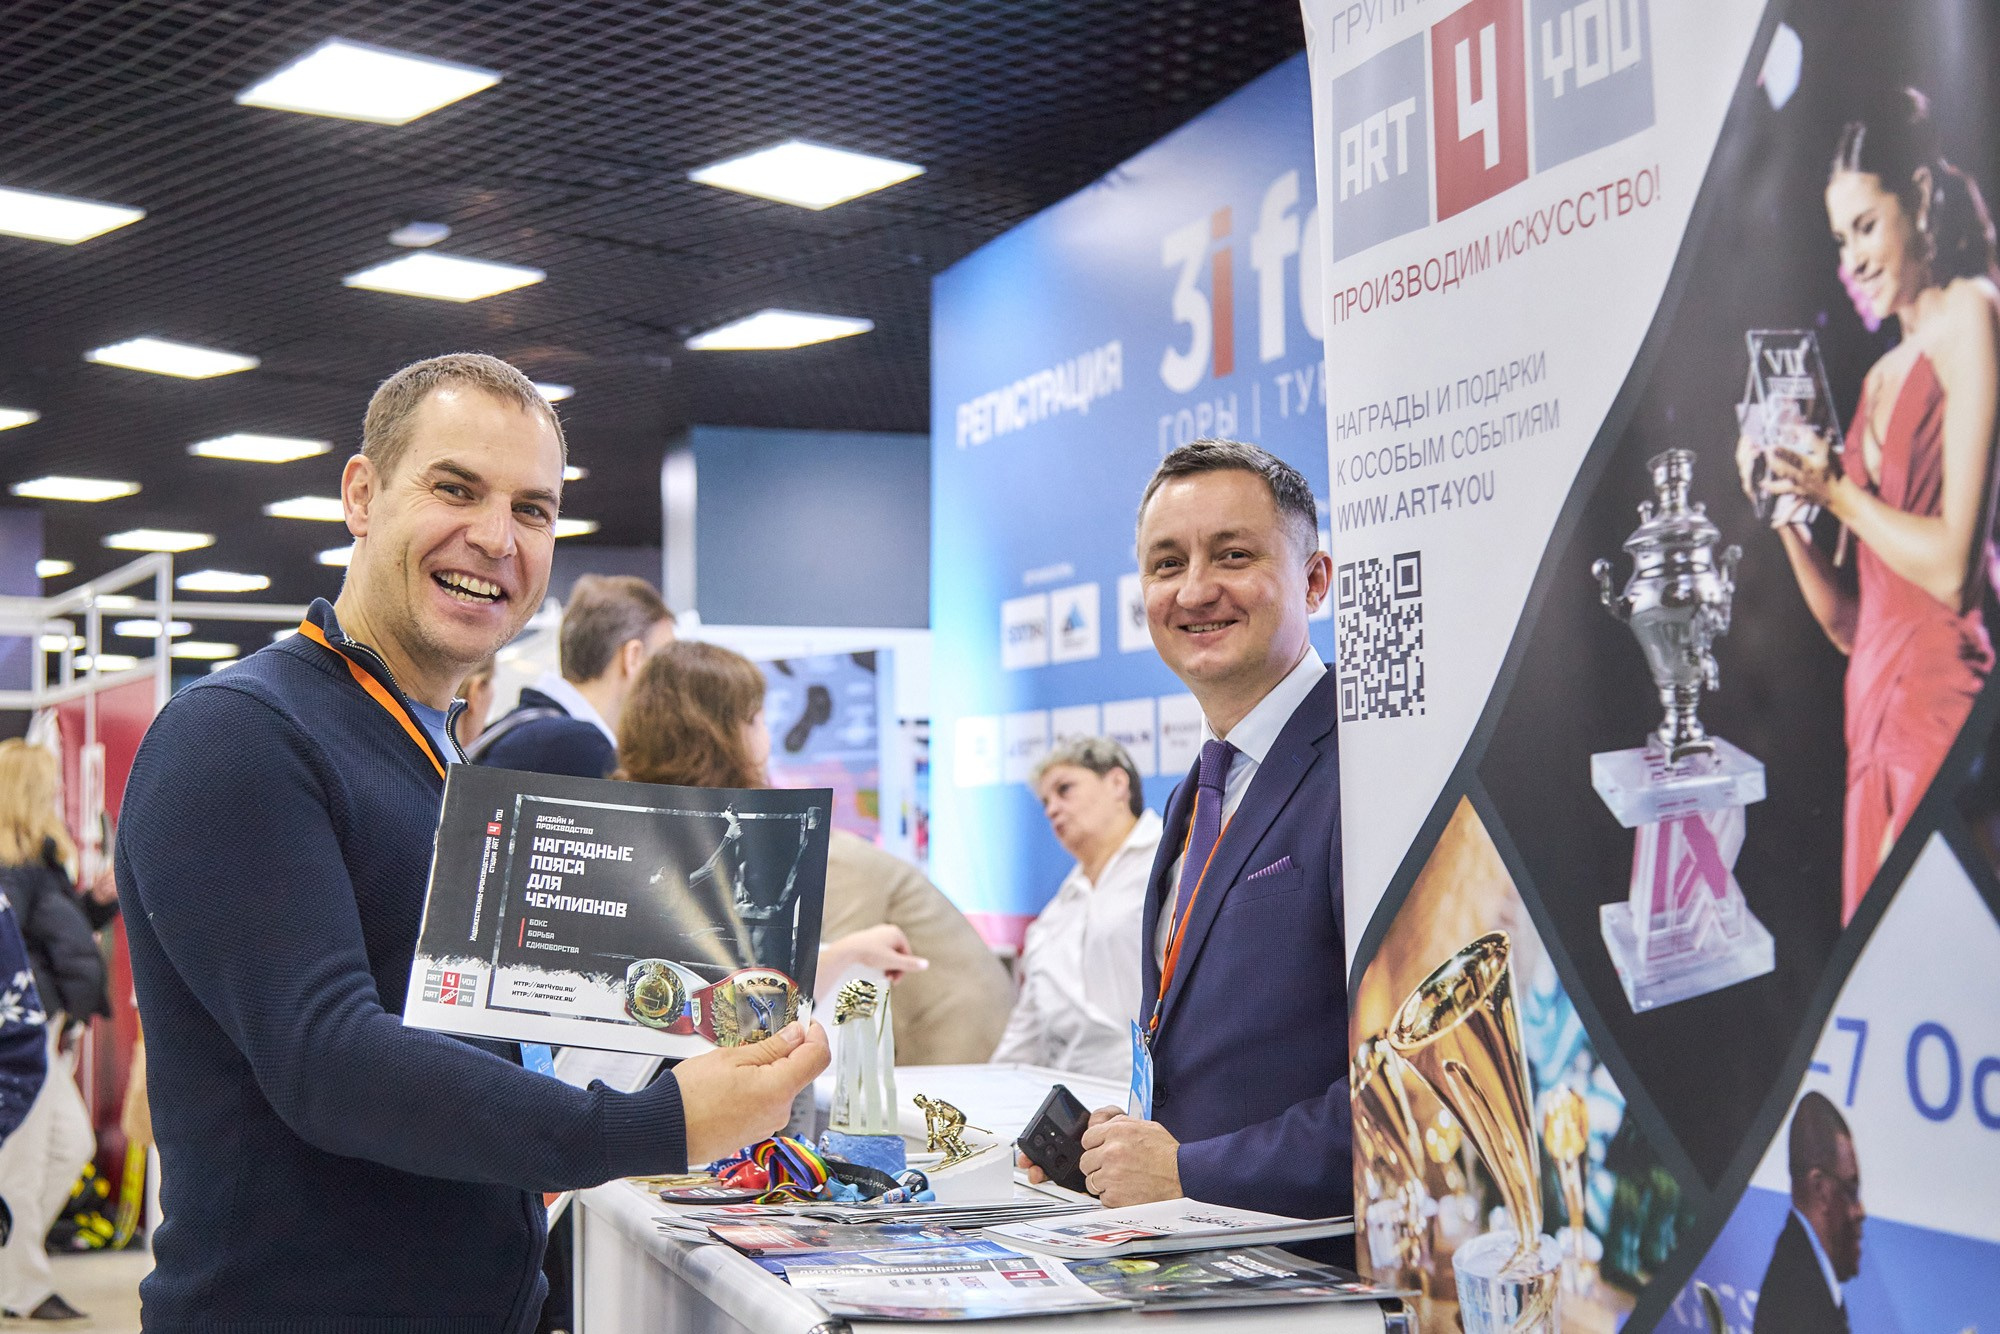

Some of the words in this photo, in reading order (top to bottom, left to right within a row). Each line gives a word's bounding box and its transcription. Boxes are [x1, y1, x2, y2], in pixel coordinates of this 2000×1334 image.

[1340, 97, 1416, 203] ART
[1455, 22, 1500, 171] 4
[1541, 0, 1642, 100] YOU
[1333, 235, 1490, 325] ПРОИЗВОДИМ
[1498, 164, 1662, 263] ИСКУССТВО!
[955, 340, 1124, 450] РЕГИСТРАЦИЯ
[1336, 383, 1430, 442] НАГРАДЫ
[1437, 384, 1451, 415] И
[1457, 350, 1547, 410] ПОДАРКИ
[1158, 392, 1239, 455] ГОРЫ
[1336, 460, 1347, 487] К
[1350, 434, 1445, 484] ОСОБЫМ
[1451, 398, 1561, 460] СОБЫТИЯМ
[1336, 469, 1497, 534] WWW.ART4YOU
[530, 854, 585, 876] ПОЯСА
[532, 836, 634, 862] НАГРАДНЫЕ
[525, 891, 628, 918] ЧЕМПИОНОВ
[526, 873, 563, 892] ДЛЯ
[527, 929, 555, 940] БОРЬБА
[528, 918, 549, 928] БОКС
[525, 941, 580, 955] ЕДИНОБОРСТВА
